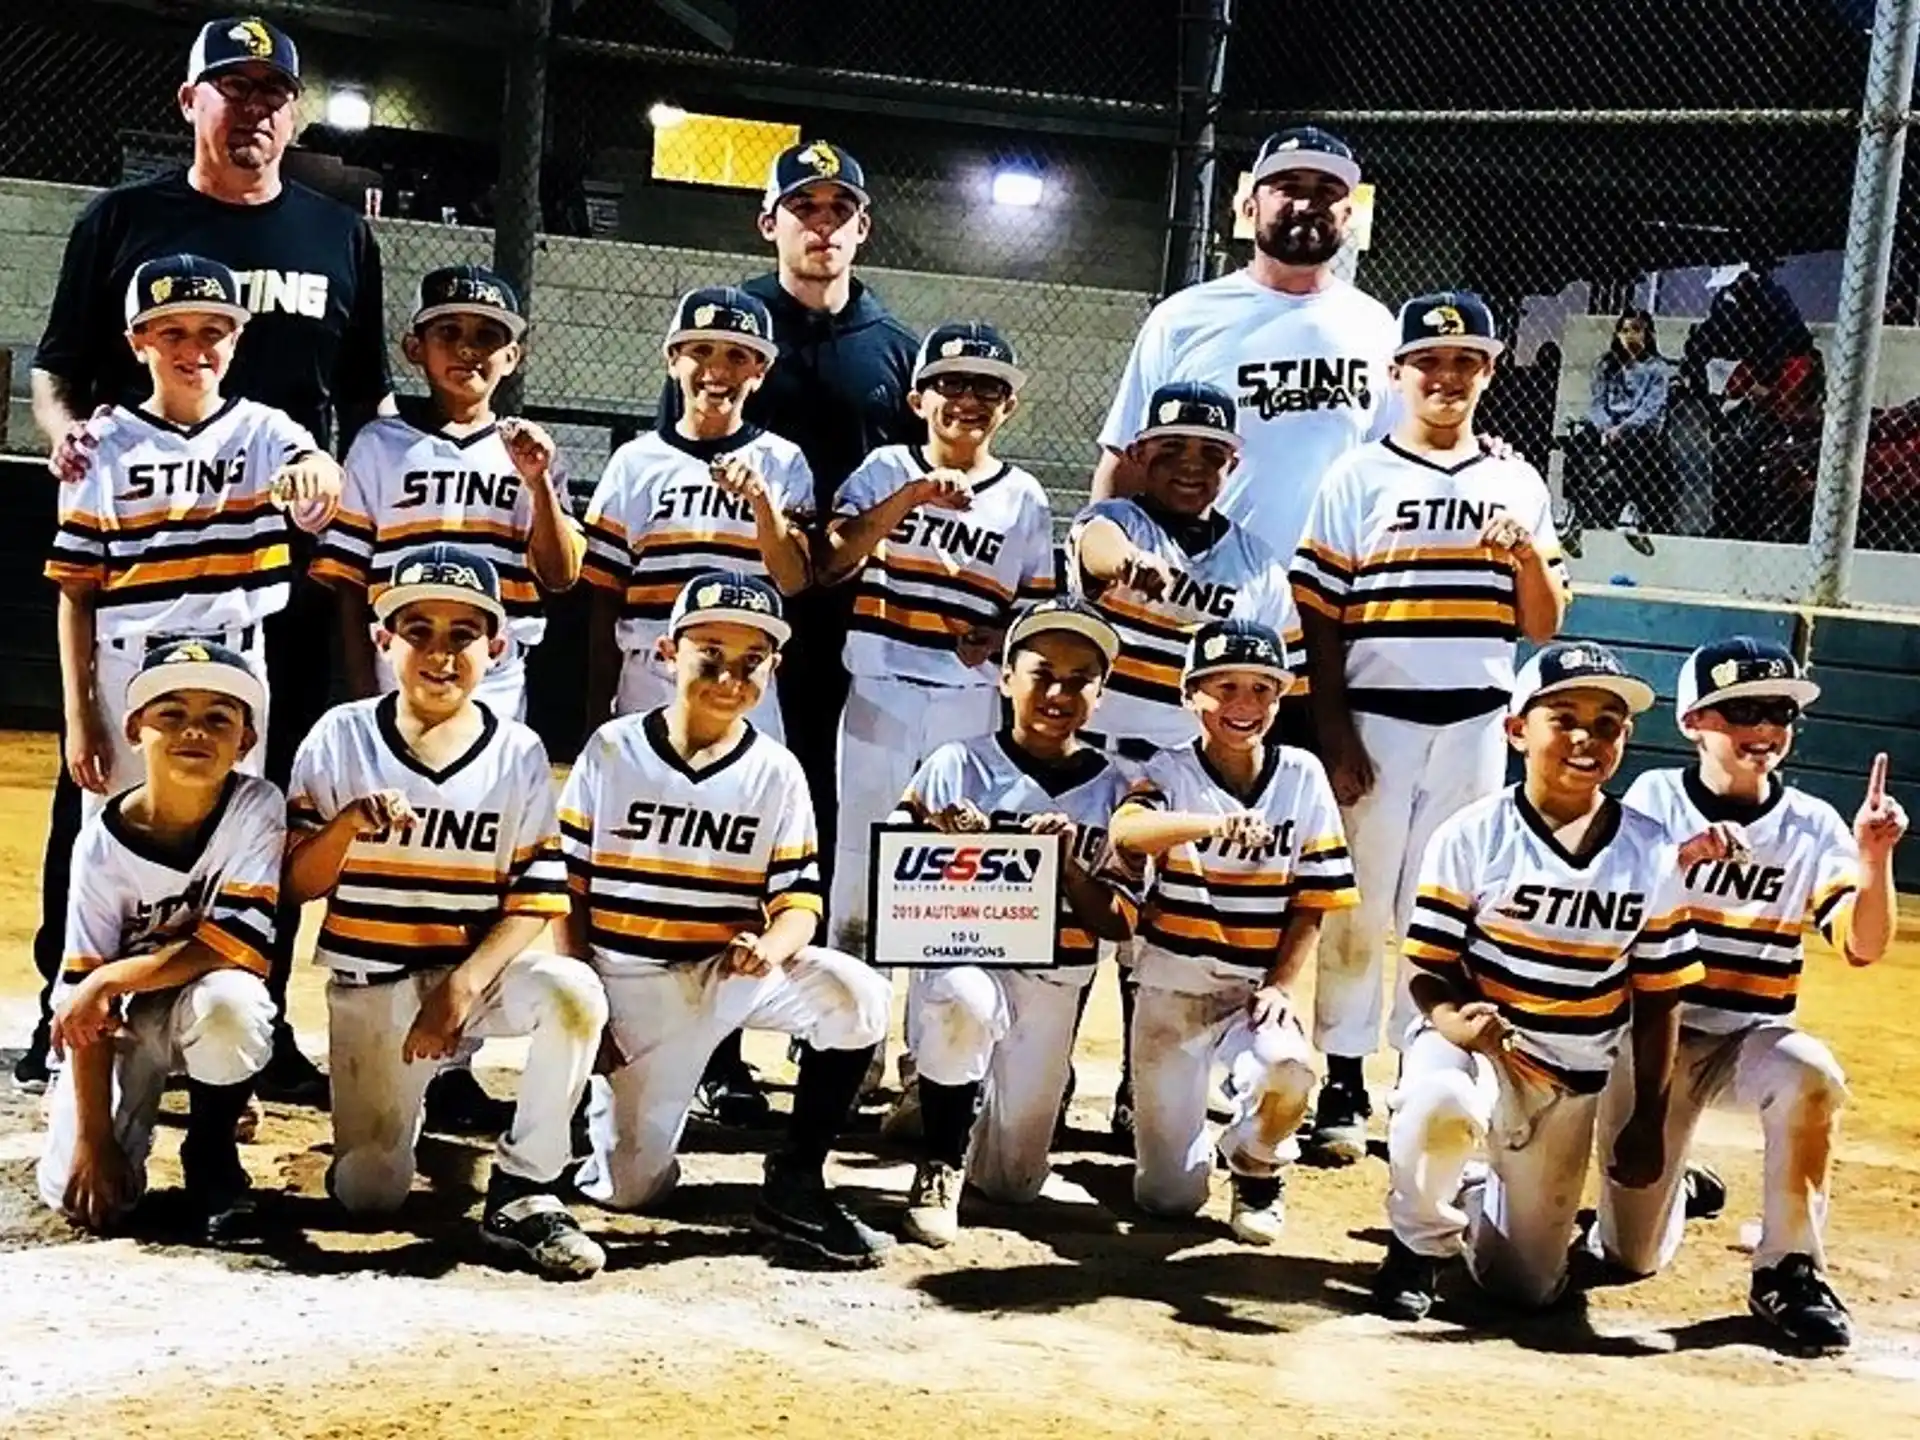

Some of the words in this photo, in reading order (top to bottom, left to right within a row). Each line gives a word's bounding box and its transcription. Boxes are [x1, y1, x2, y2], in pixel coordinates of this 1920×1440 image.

[232, 269, 329, 319] TING
[1238, 357, 1369, 407] STING
[113, 447, 246, 500] STING
[391, 470, 521, 511] STING
[885, 511, 1005, 566] STING
[1387, 498, 1507, 532] STIN
[609, 802, 761, 855] STING
[892, 904, 920, 920] 2019
[923, 904, 980, 920] AUTUMN
[983, 905, 1040, 920] CLASSIC
[1494, 884, 1645, 931] STING
[922, 944, 1007, 958] CHAMPIONS
[968, 931, 980, 943] U
